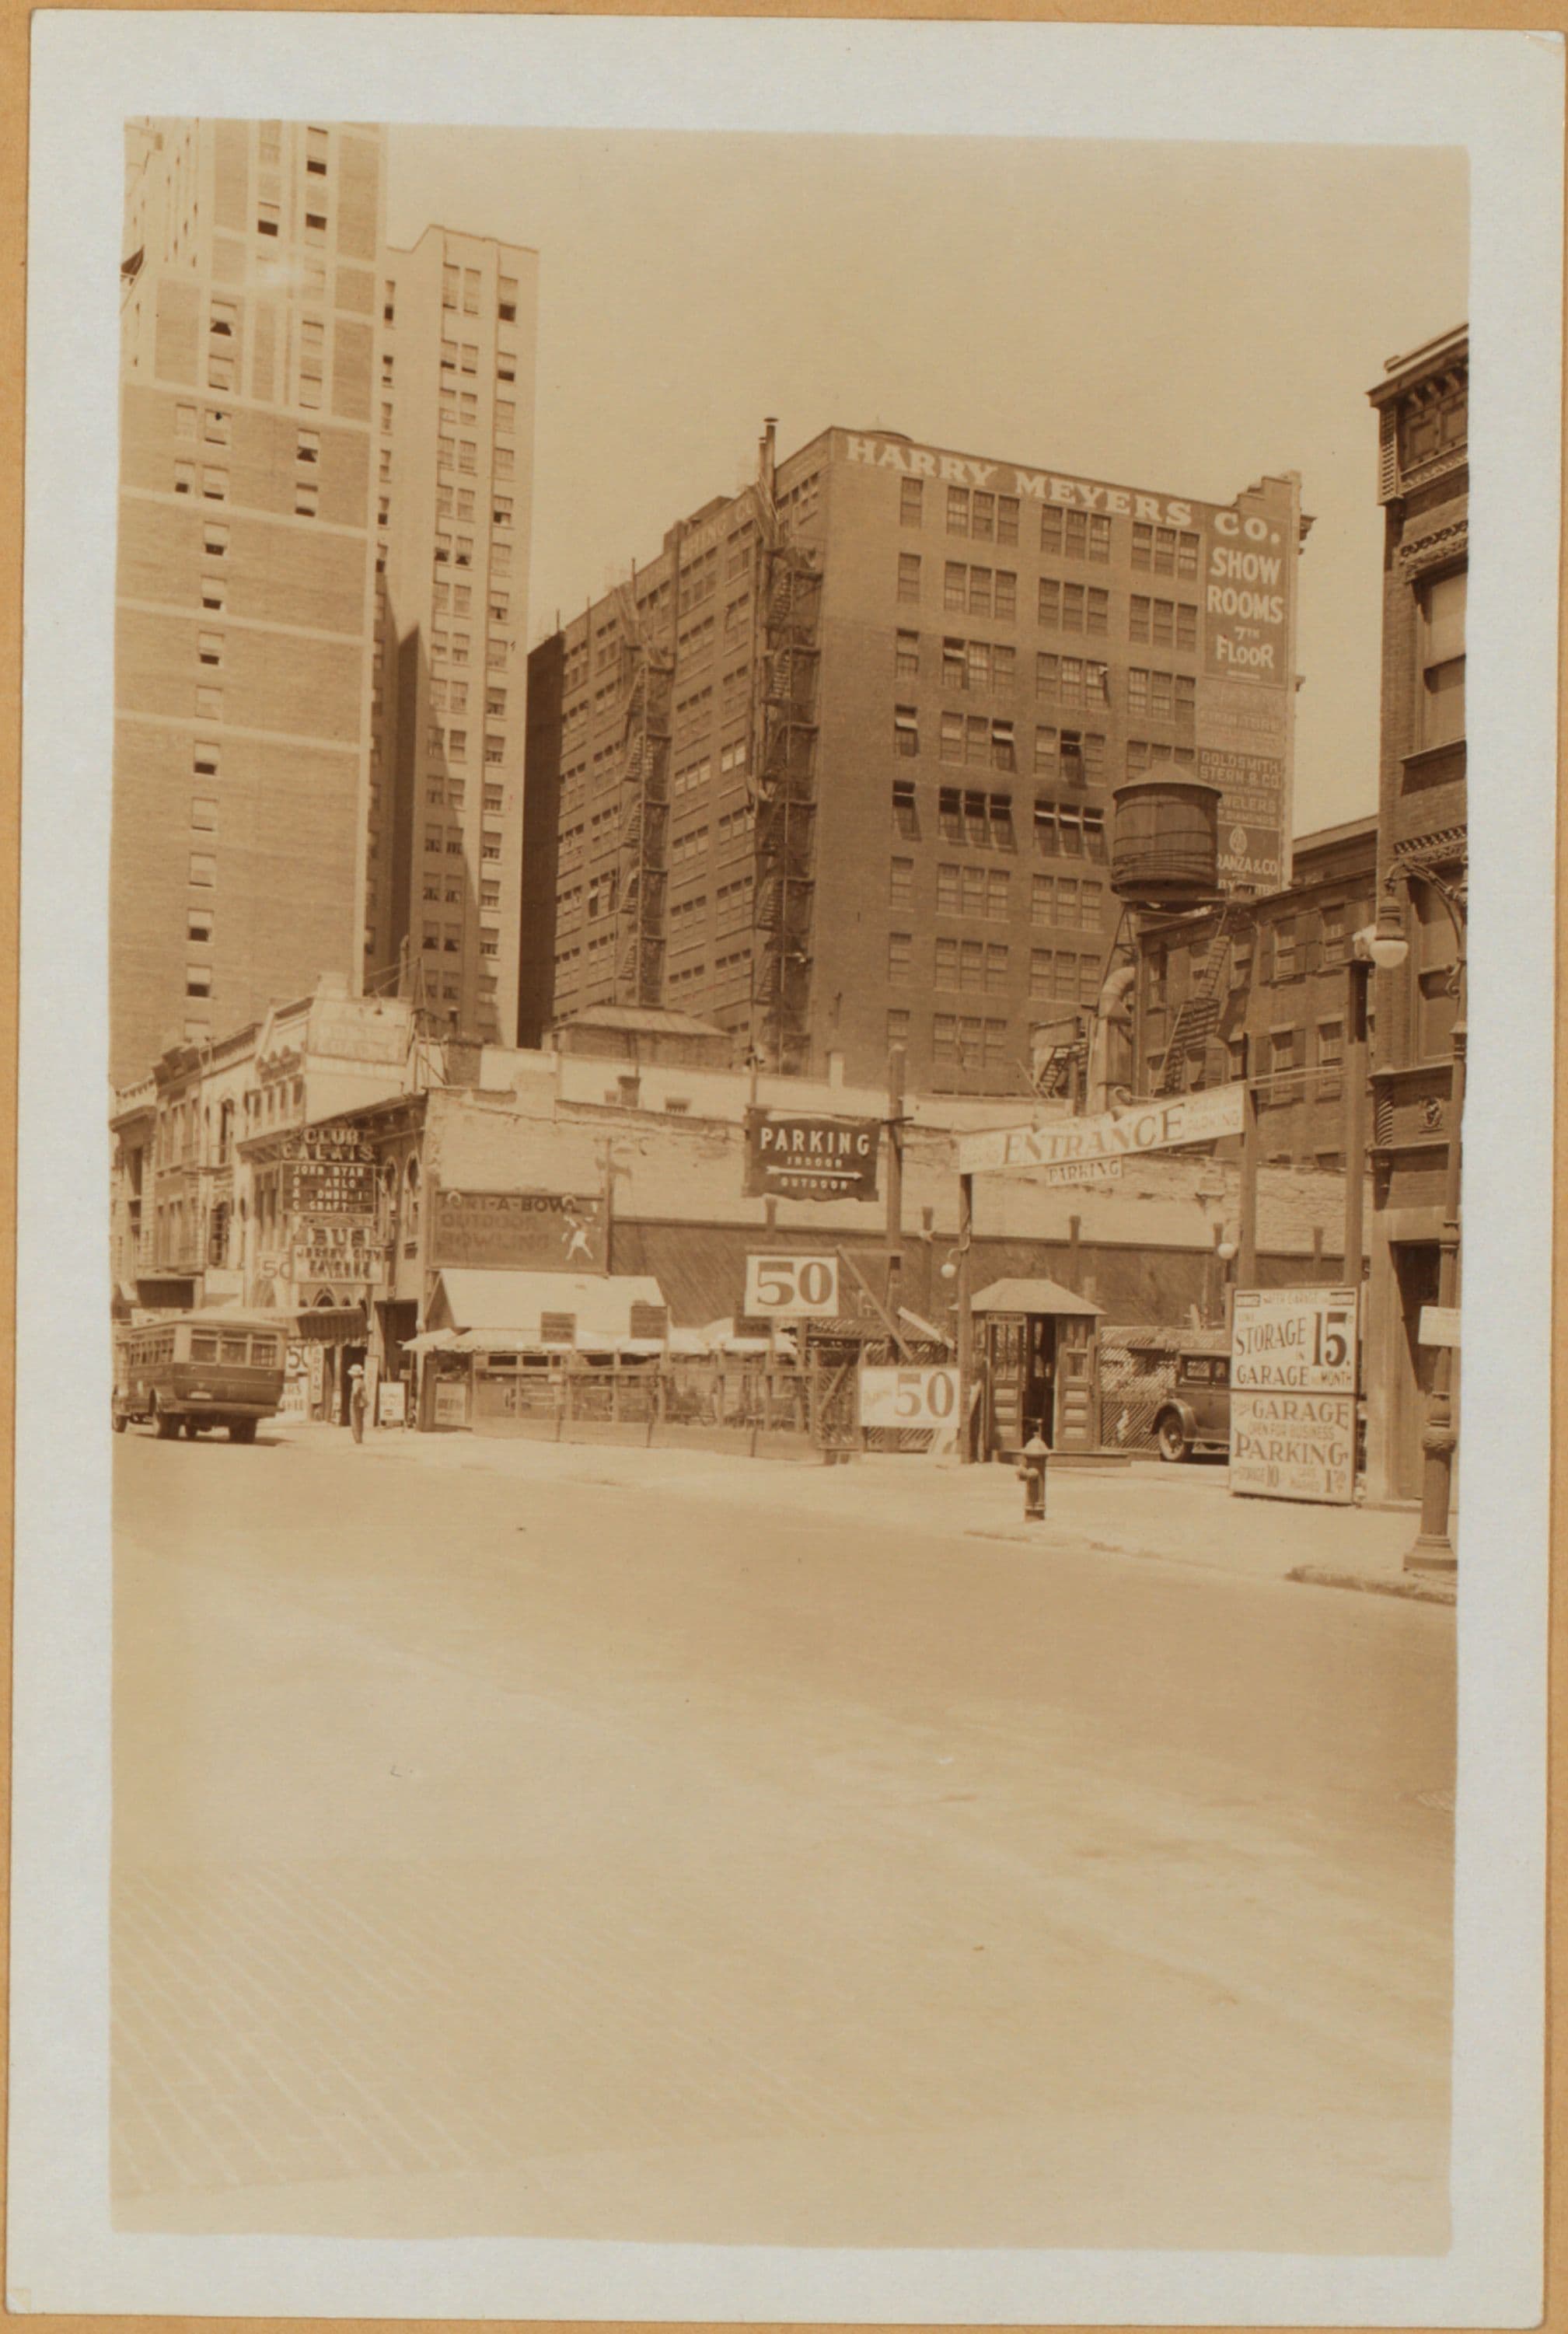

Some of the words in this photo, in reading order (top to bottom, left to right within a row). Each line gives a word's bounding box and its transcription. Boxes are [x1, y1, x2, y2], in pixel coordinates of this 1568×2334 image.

[847, 435, 997, 487] HARRY
[1014, 470, 1192, 526] MEYERS
[1214, 510, 1281, 543] CO.
[1210, 547, 1281, 585] SHOW
[1207, 585, 1283, 624] ROOMS
[1216, 634, 1274, 669] FLOOR
[1200, 765, 1244, 784] STERN
[303, 1127, 358, 1145] CLUB
[760, 1127, 871, 1156] PARKING
[1003, 1102, 1186, 1165] ENTRANCE
[786, 1156, 843, 1169] INDOOR
[1049, 1158, 1120, 1184] PARKING
[780, 1176, 848, 1190] OUTDOOR
[757, 1261, 833, 1307] 50
[1236, 1316, 1306, 1357] STORAGE
[1236, 1364, 1309, 1387] GARAGE
[1320, 1369, 1353, 1386] MONTH
[893, 1371, 956, 1419] 50
[1252, 1399, 1350, 1431] GARAGE
[1234, 1427, 1350, 1466] PARKING
